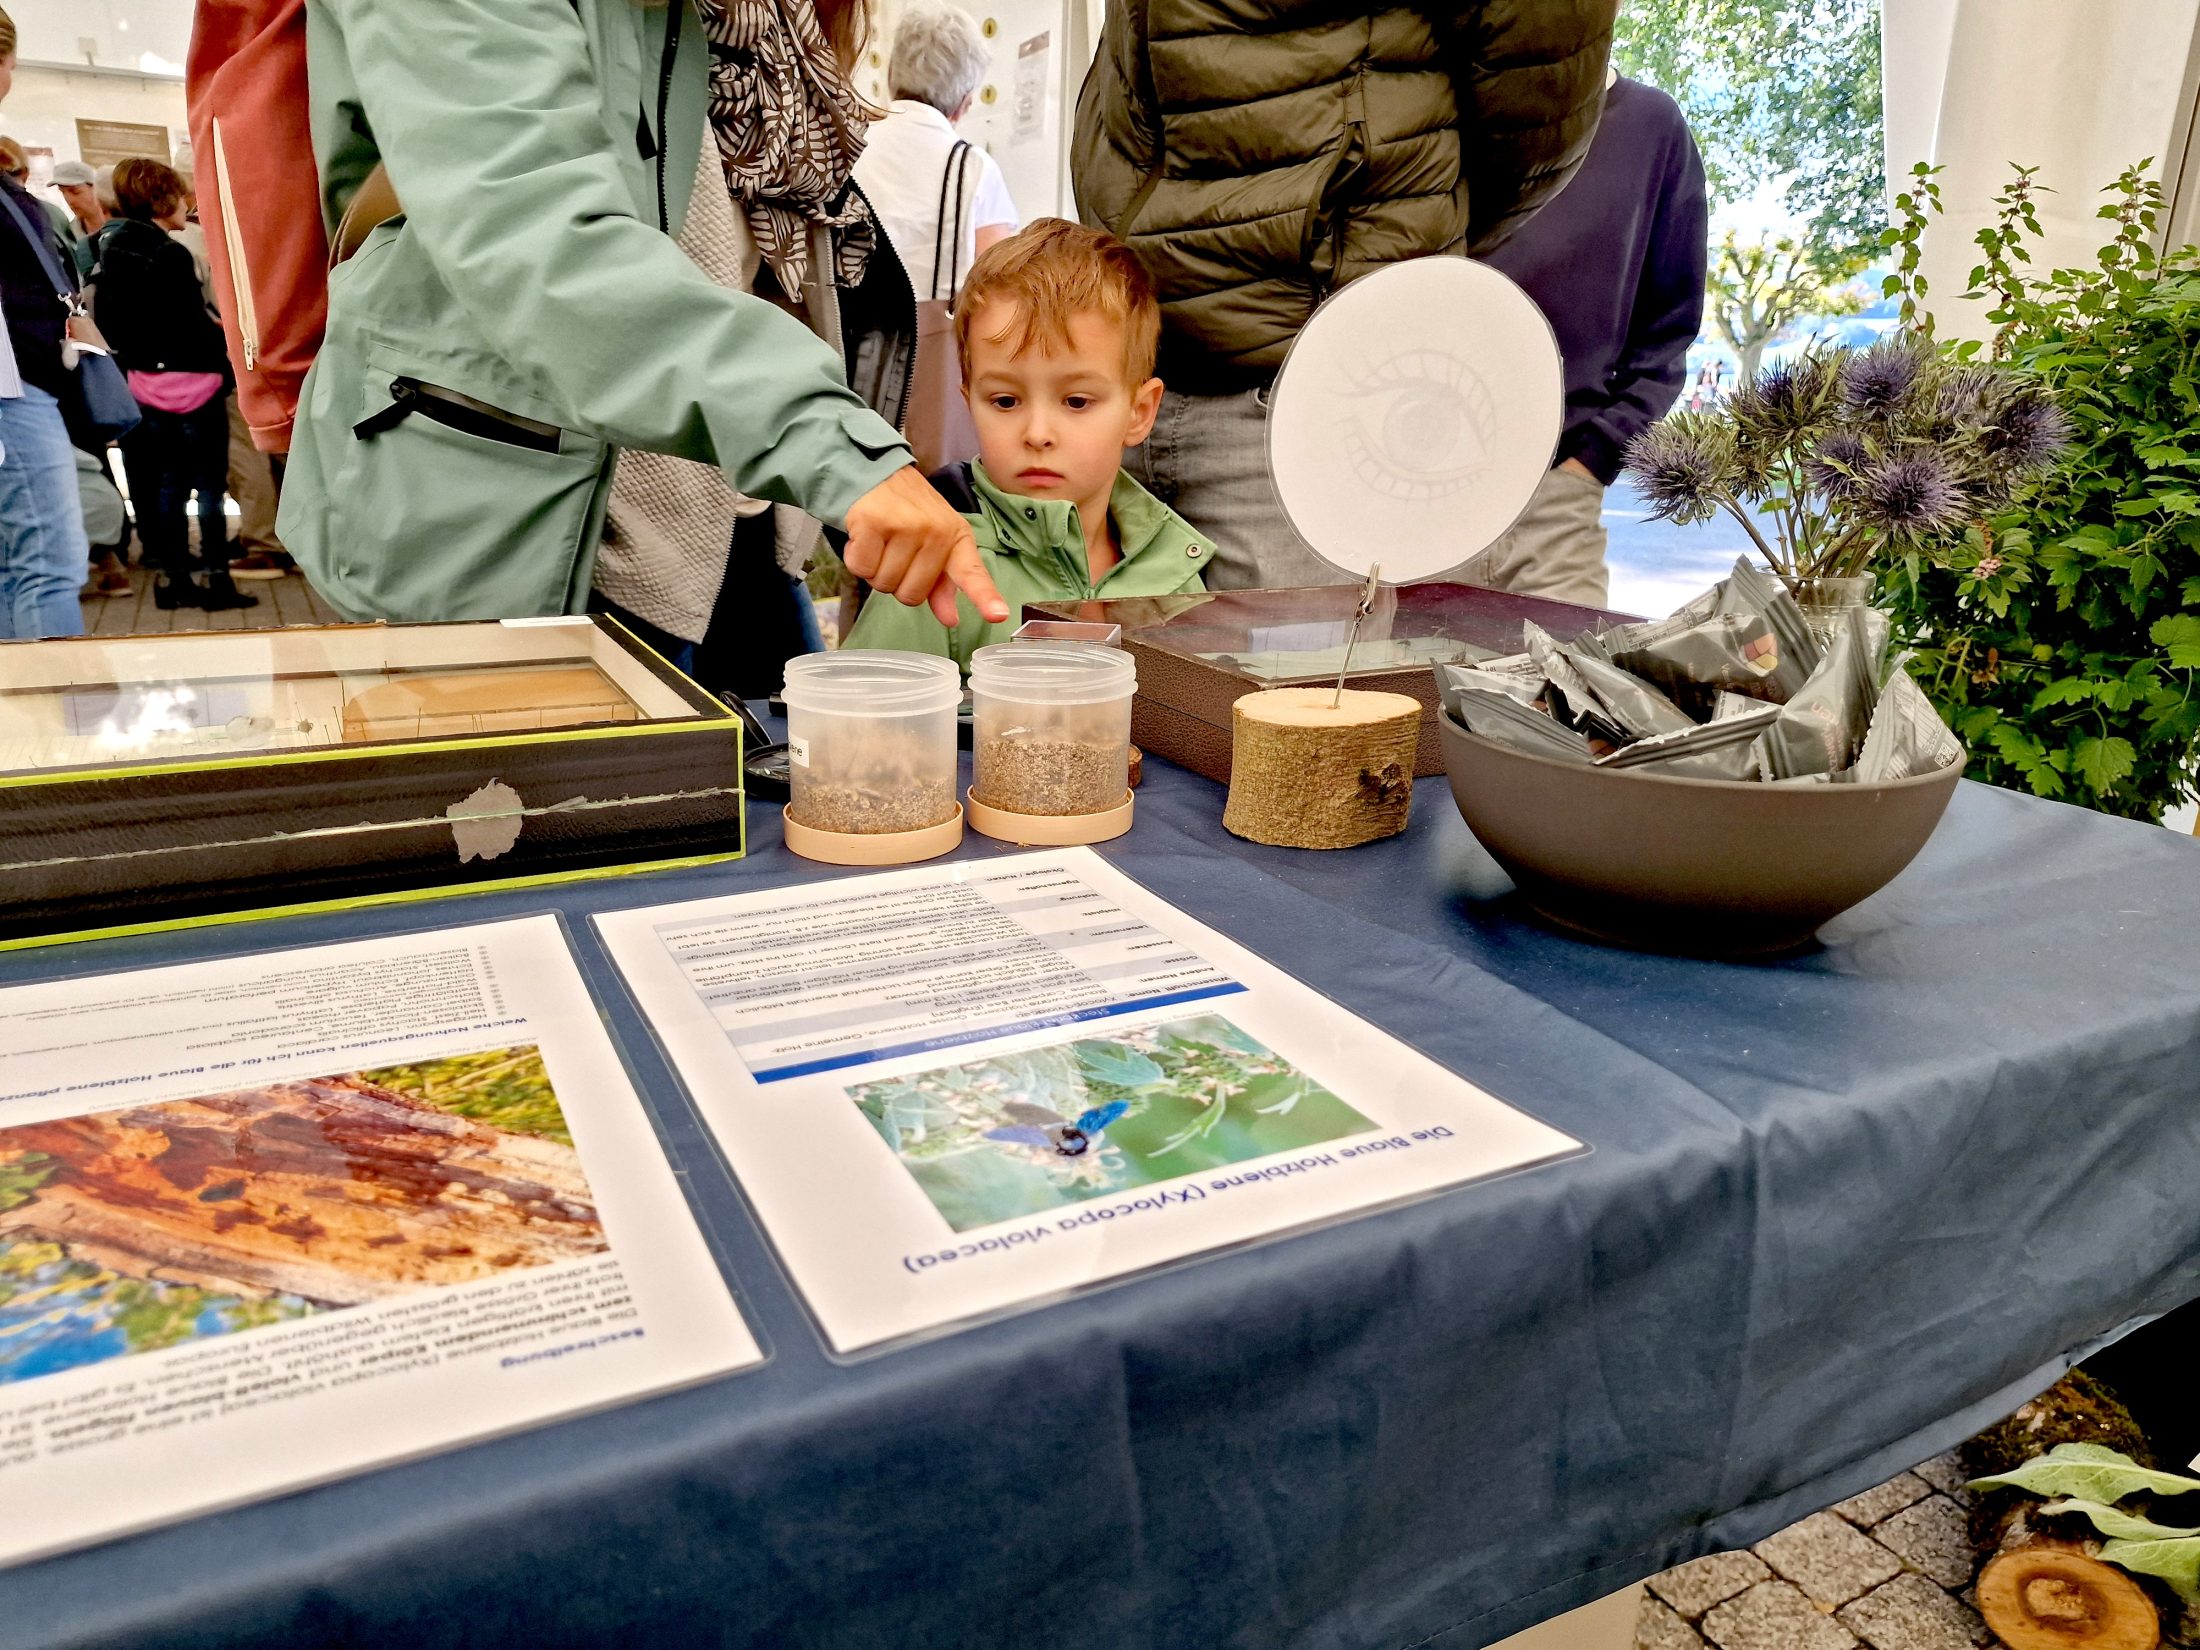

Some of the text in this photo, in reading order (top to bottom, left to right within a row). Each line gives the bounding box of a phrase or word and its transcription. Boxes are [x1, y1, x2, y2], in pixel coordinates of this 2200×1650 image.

[1160, 955, 1199, 964] Grösse:
[1136, 966, 1216, 983] Andere Namen:
[1124, 975, 1231, 998] Wissenschaftl. Name:
[471, 1017, 526, 1029] Welche
[339, 1026, 469, 1049] Nahrungsquellen
[294, 1046, 336, 1056] kann
[240, 1057, 262, 1065] für
[265, 1053, 292, 1062] ich
[209, 1061, 237, 1069] die
[156, 1066, 206, 1077] Blaue
[65, 1074, 152, 1092] Holzbiene
[899, 1125, 1456, 1274] Die Blaue Holzbiene (Xylocopa violacea)
[499, 1327, 644, 1367] Beschreibung
